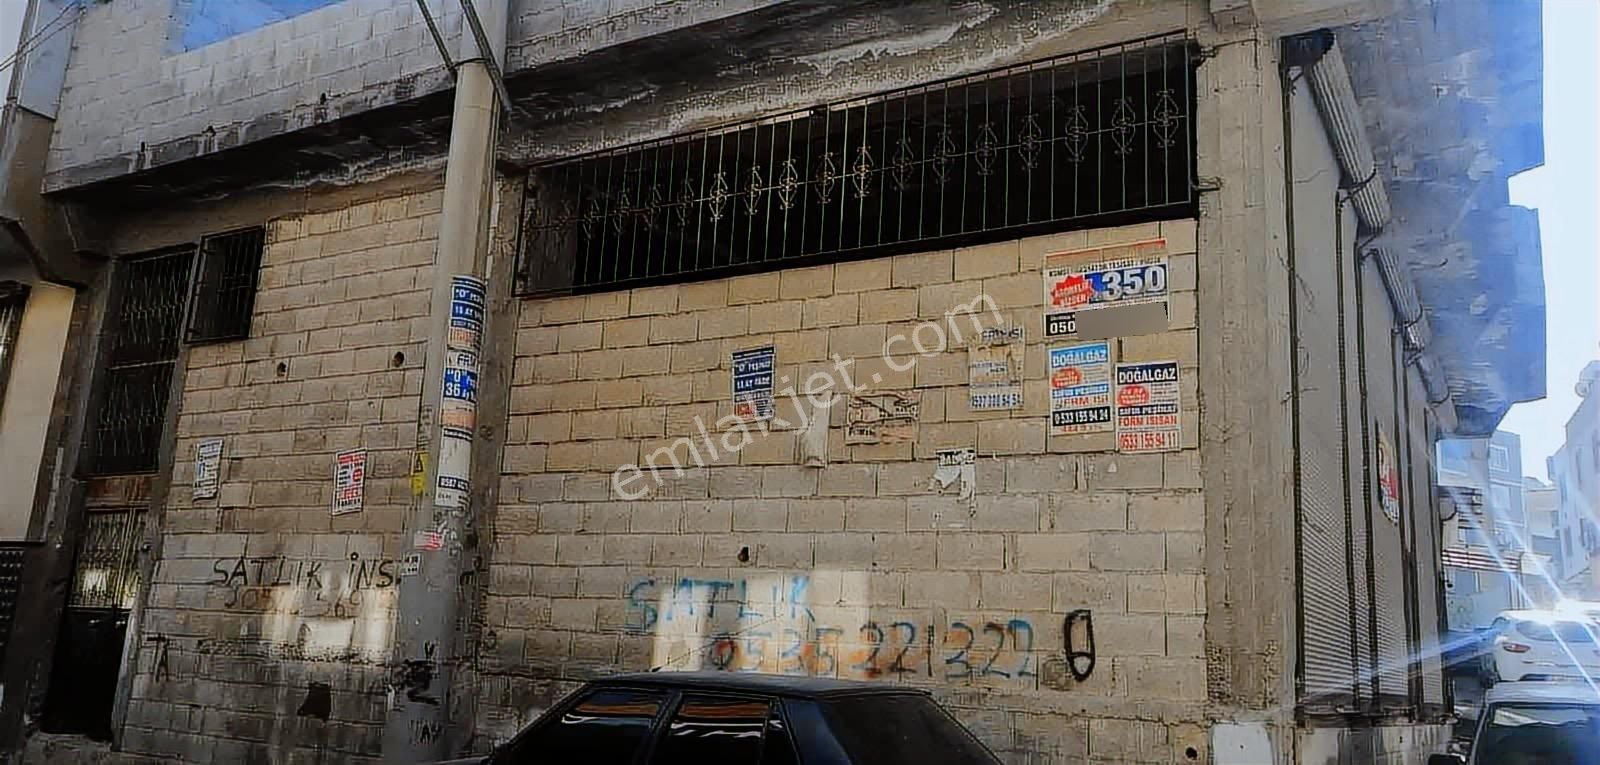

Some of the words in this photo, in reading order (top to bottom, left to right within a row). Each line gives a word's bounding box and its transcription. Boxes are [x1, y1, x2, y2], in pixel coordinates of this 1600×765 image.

[1101, 265, 1166, 301] 350
[1119, 367, 1177, 384] DOĞALGAZ
[445, 382, 461, 397] 36
